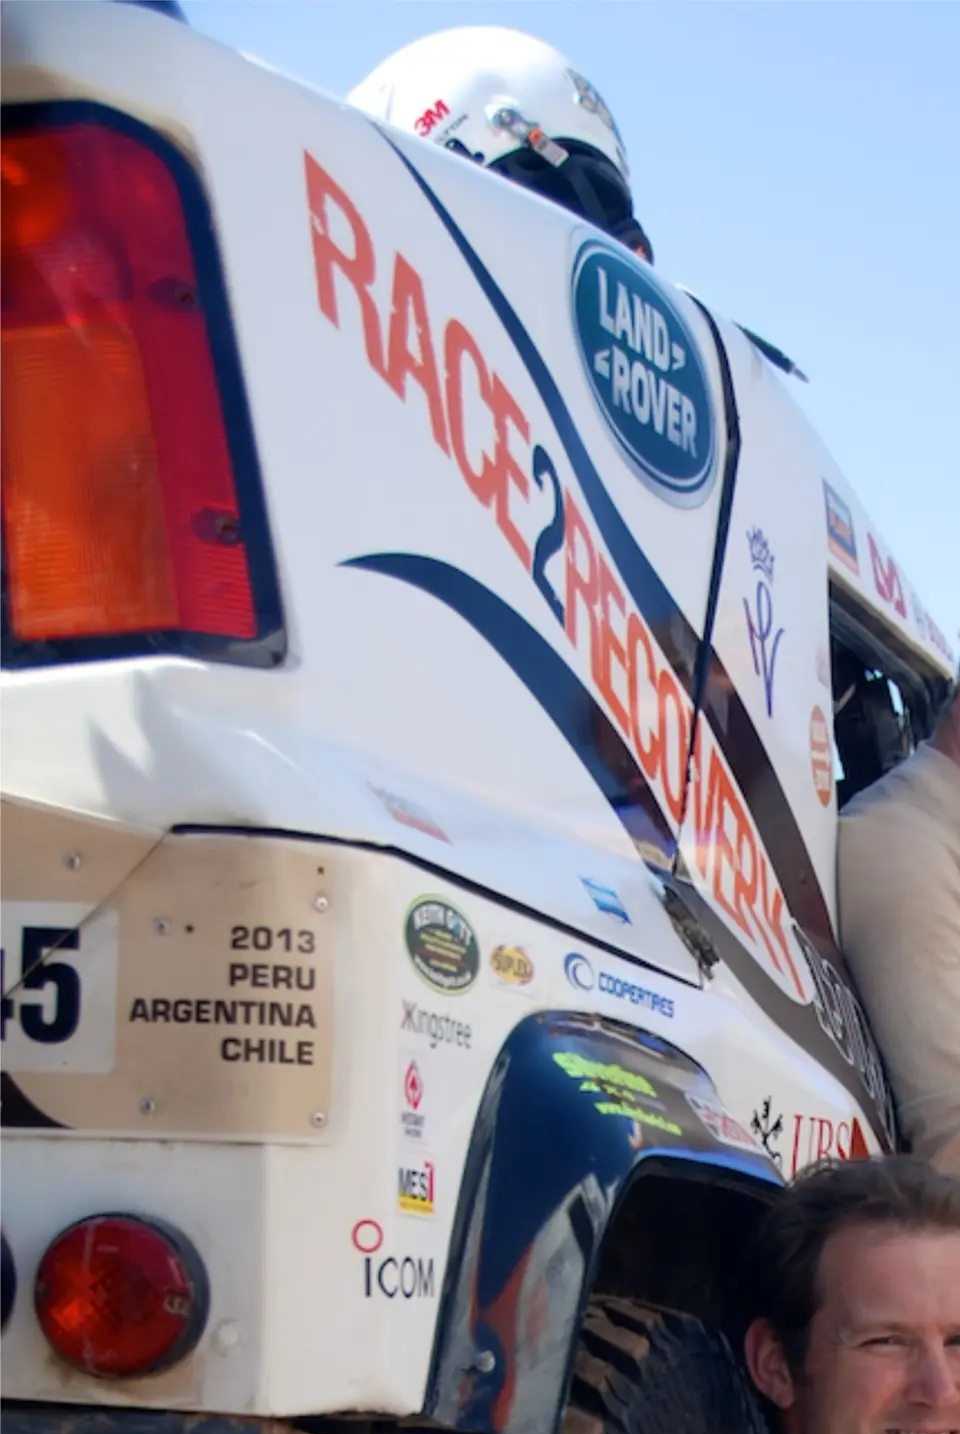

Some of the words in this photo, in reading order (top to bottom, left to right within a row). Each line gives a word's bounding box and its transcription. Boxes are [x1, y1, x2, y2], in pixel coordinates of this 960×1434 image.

[413, 98, 450, 137] 3M
[597, 266, 670, 373] LAND
[611, 360, 697, 458] ROVER
[230, 926, 316, 954] 2013
[0, 926, 81, 1044] 5
[228, 964, 316, 991] PERU
[128, 998, 317, 1029] ARGENTINA
[220, 1037, 315, 1066] CHILE
